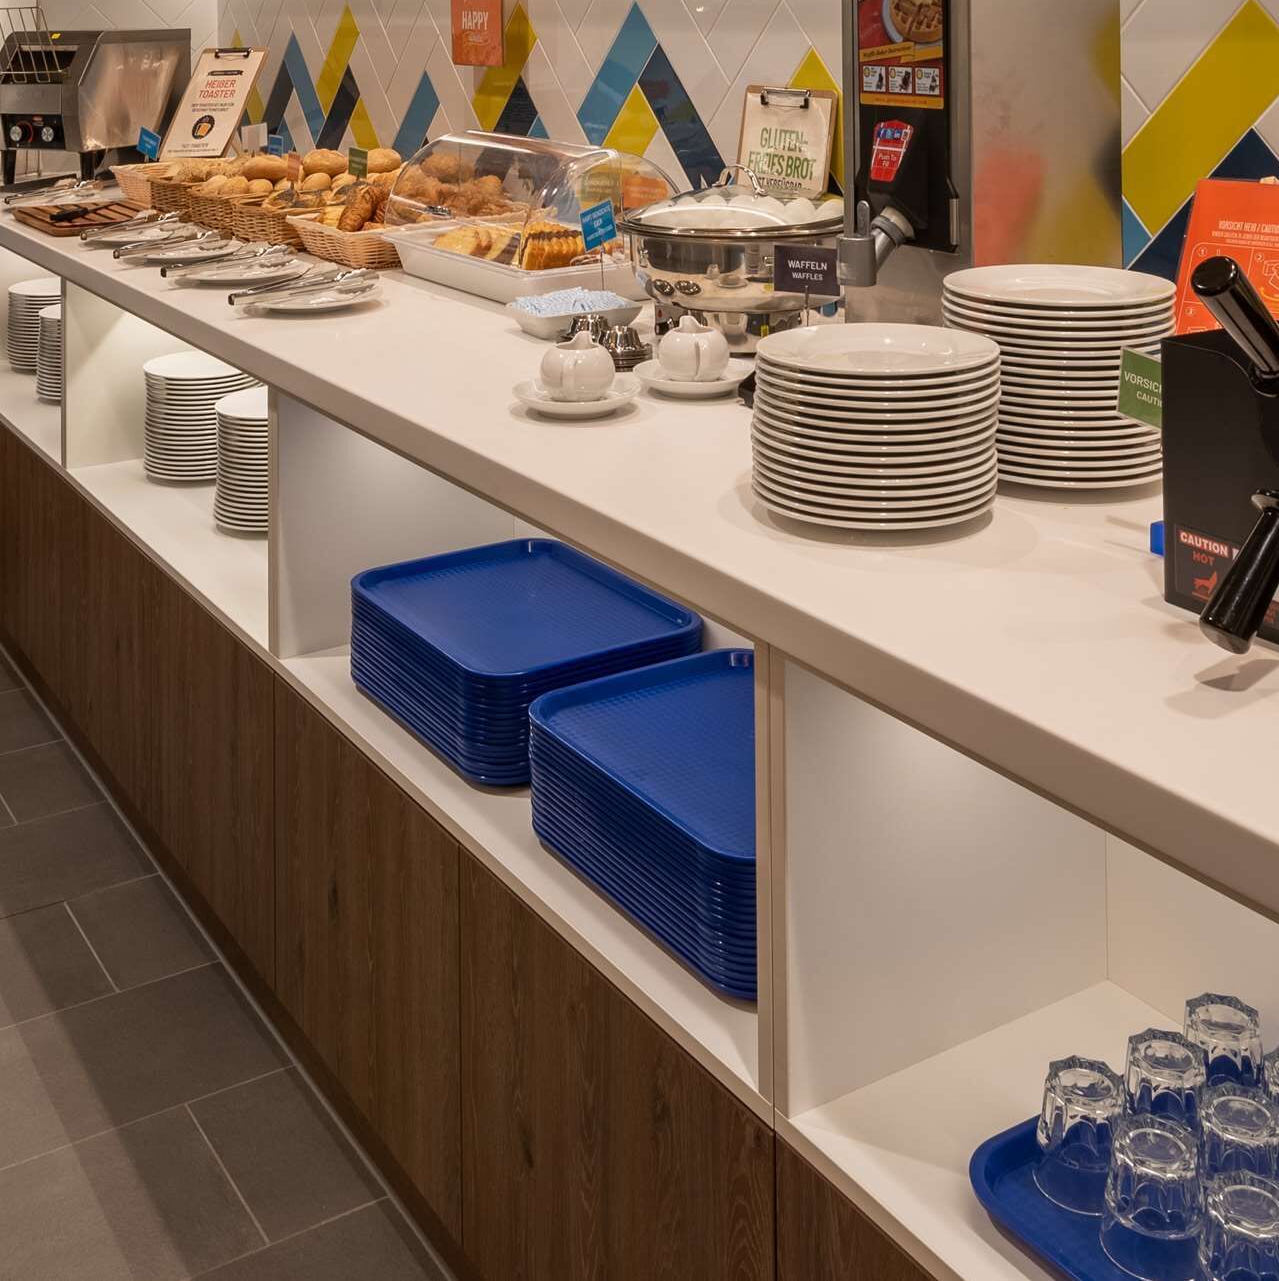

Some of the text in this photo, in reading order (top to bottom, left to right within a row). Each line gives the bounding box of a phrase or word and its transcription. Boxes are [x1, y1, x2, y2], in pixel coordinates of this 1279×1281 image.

[462, 11, 489, 31] HAPPY
[199, 90, 236, 99] TOASTER
[760, 126, 808, 153] GLUTEN-
[747, 150, 816, 181] FREIES BROT
[787, 260, 827, 270] WAFFELN
[792, 272, 823, 280] WAFFLES
[1124, 371, 1162, 394] VORSIC
[1180, 532, 1229, 558] CAUTION
[1193, 551, 1216, 566] HOT
